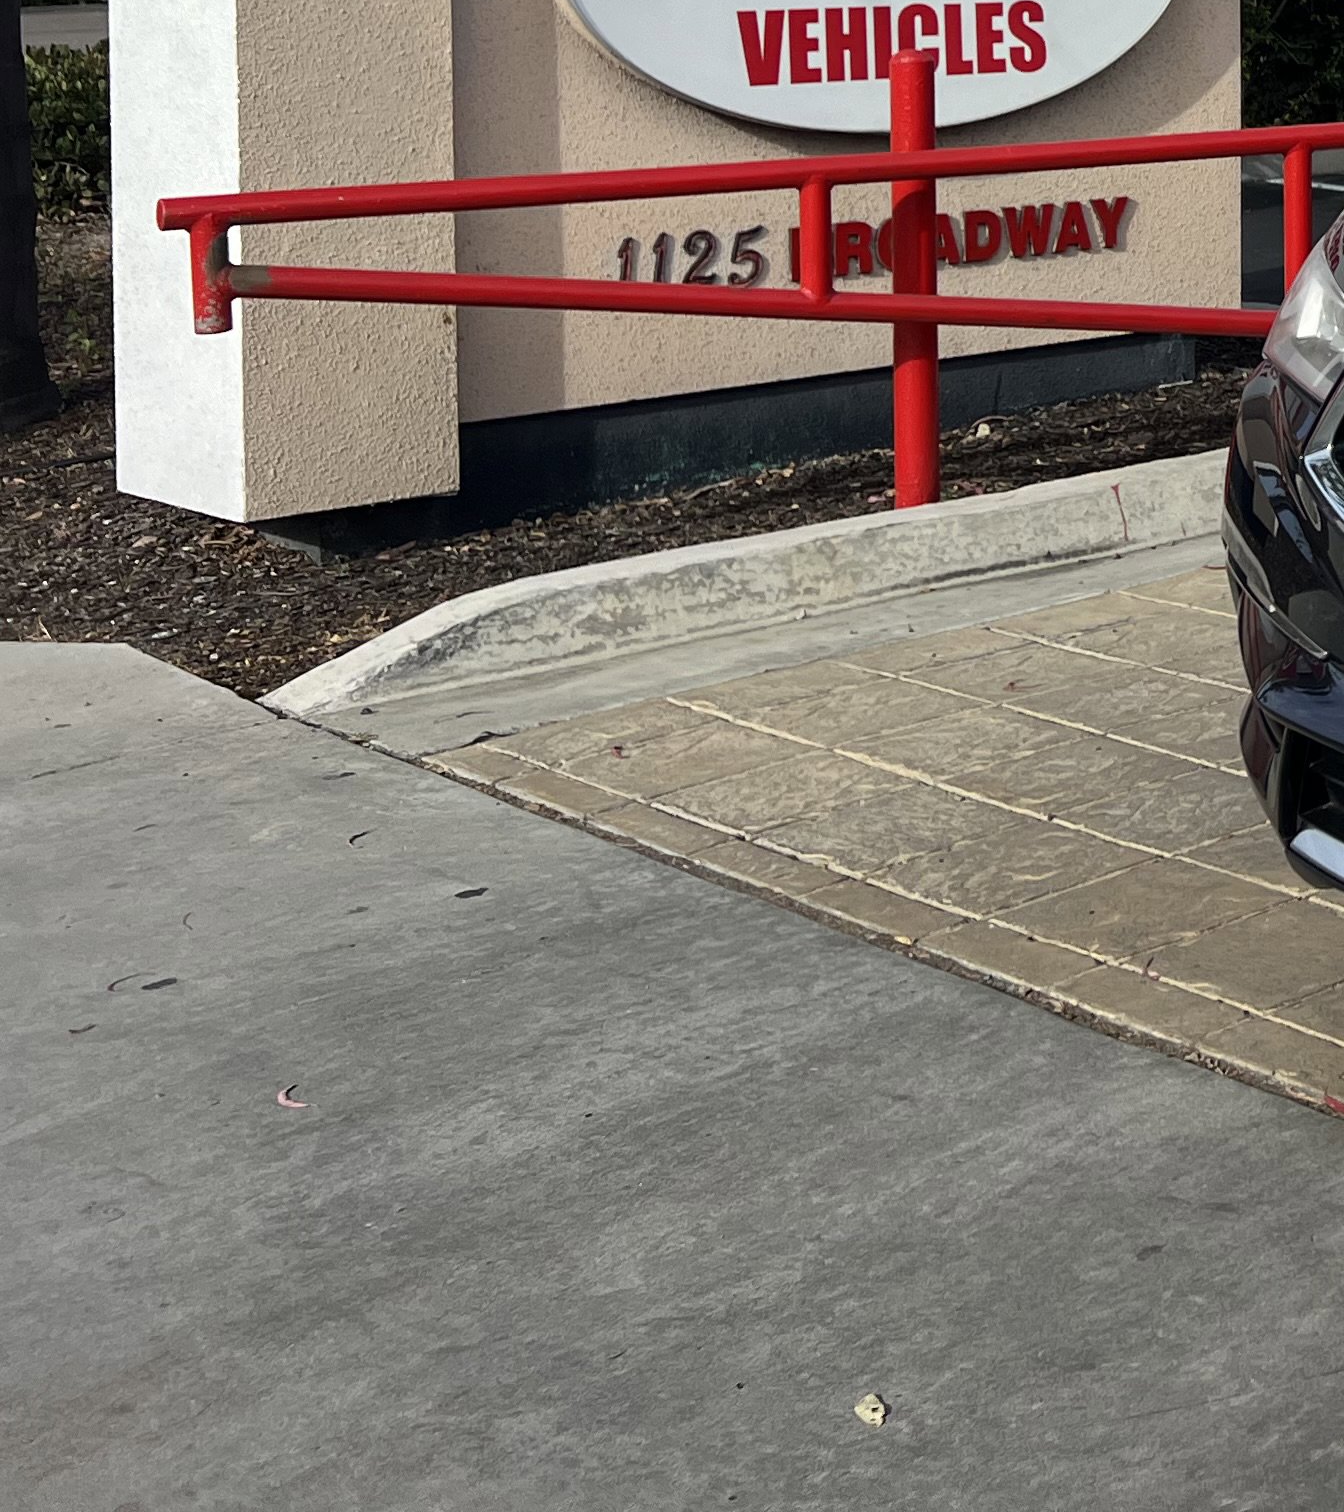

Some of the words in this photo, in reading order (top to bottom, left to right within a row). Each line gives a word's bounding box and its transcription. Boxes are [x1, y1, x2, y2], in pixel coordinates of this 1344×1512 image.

[736, 0, 1048, 87] VEHICLES
[616, 224, 768, 285] 1125
[788, 196, 1130, 283] RADWAY
